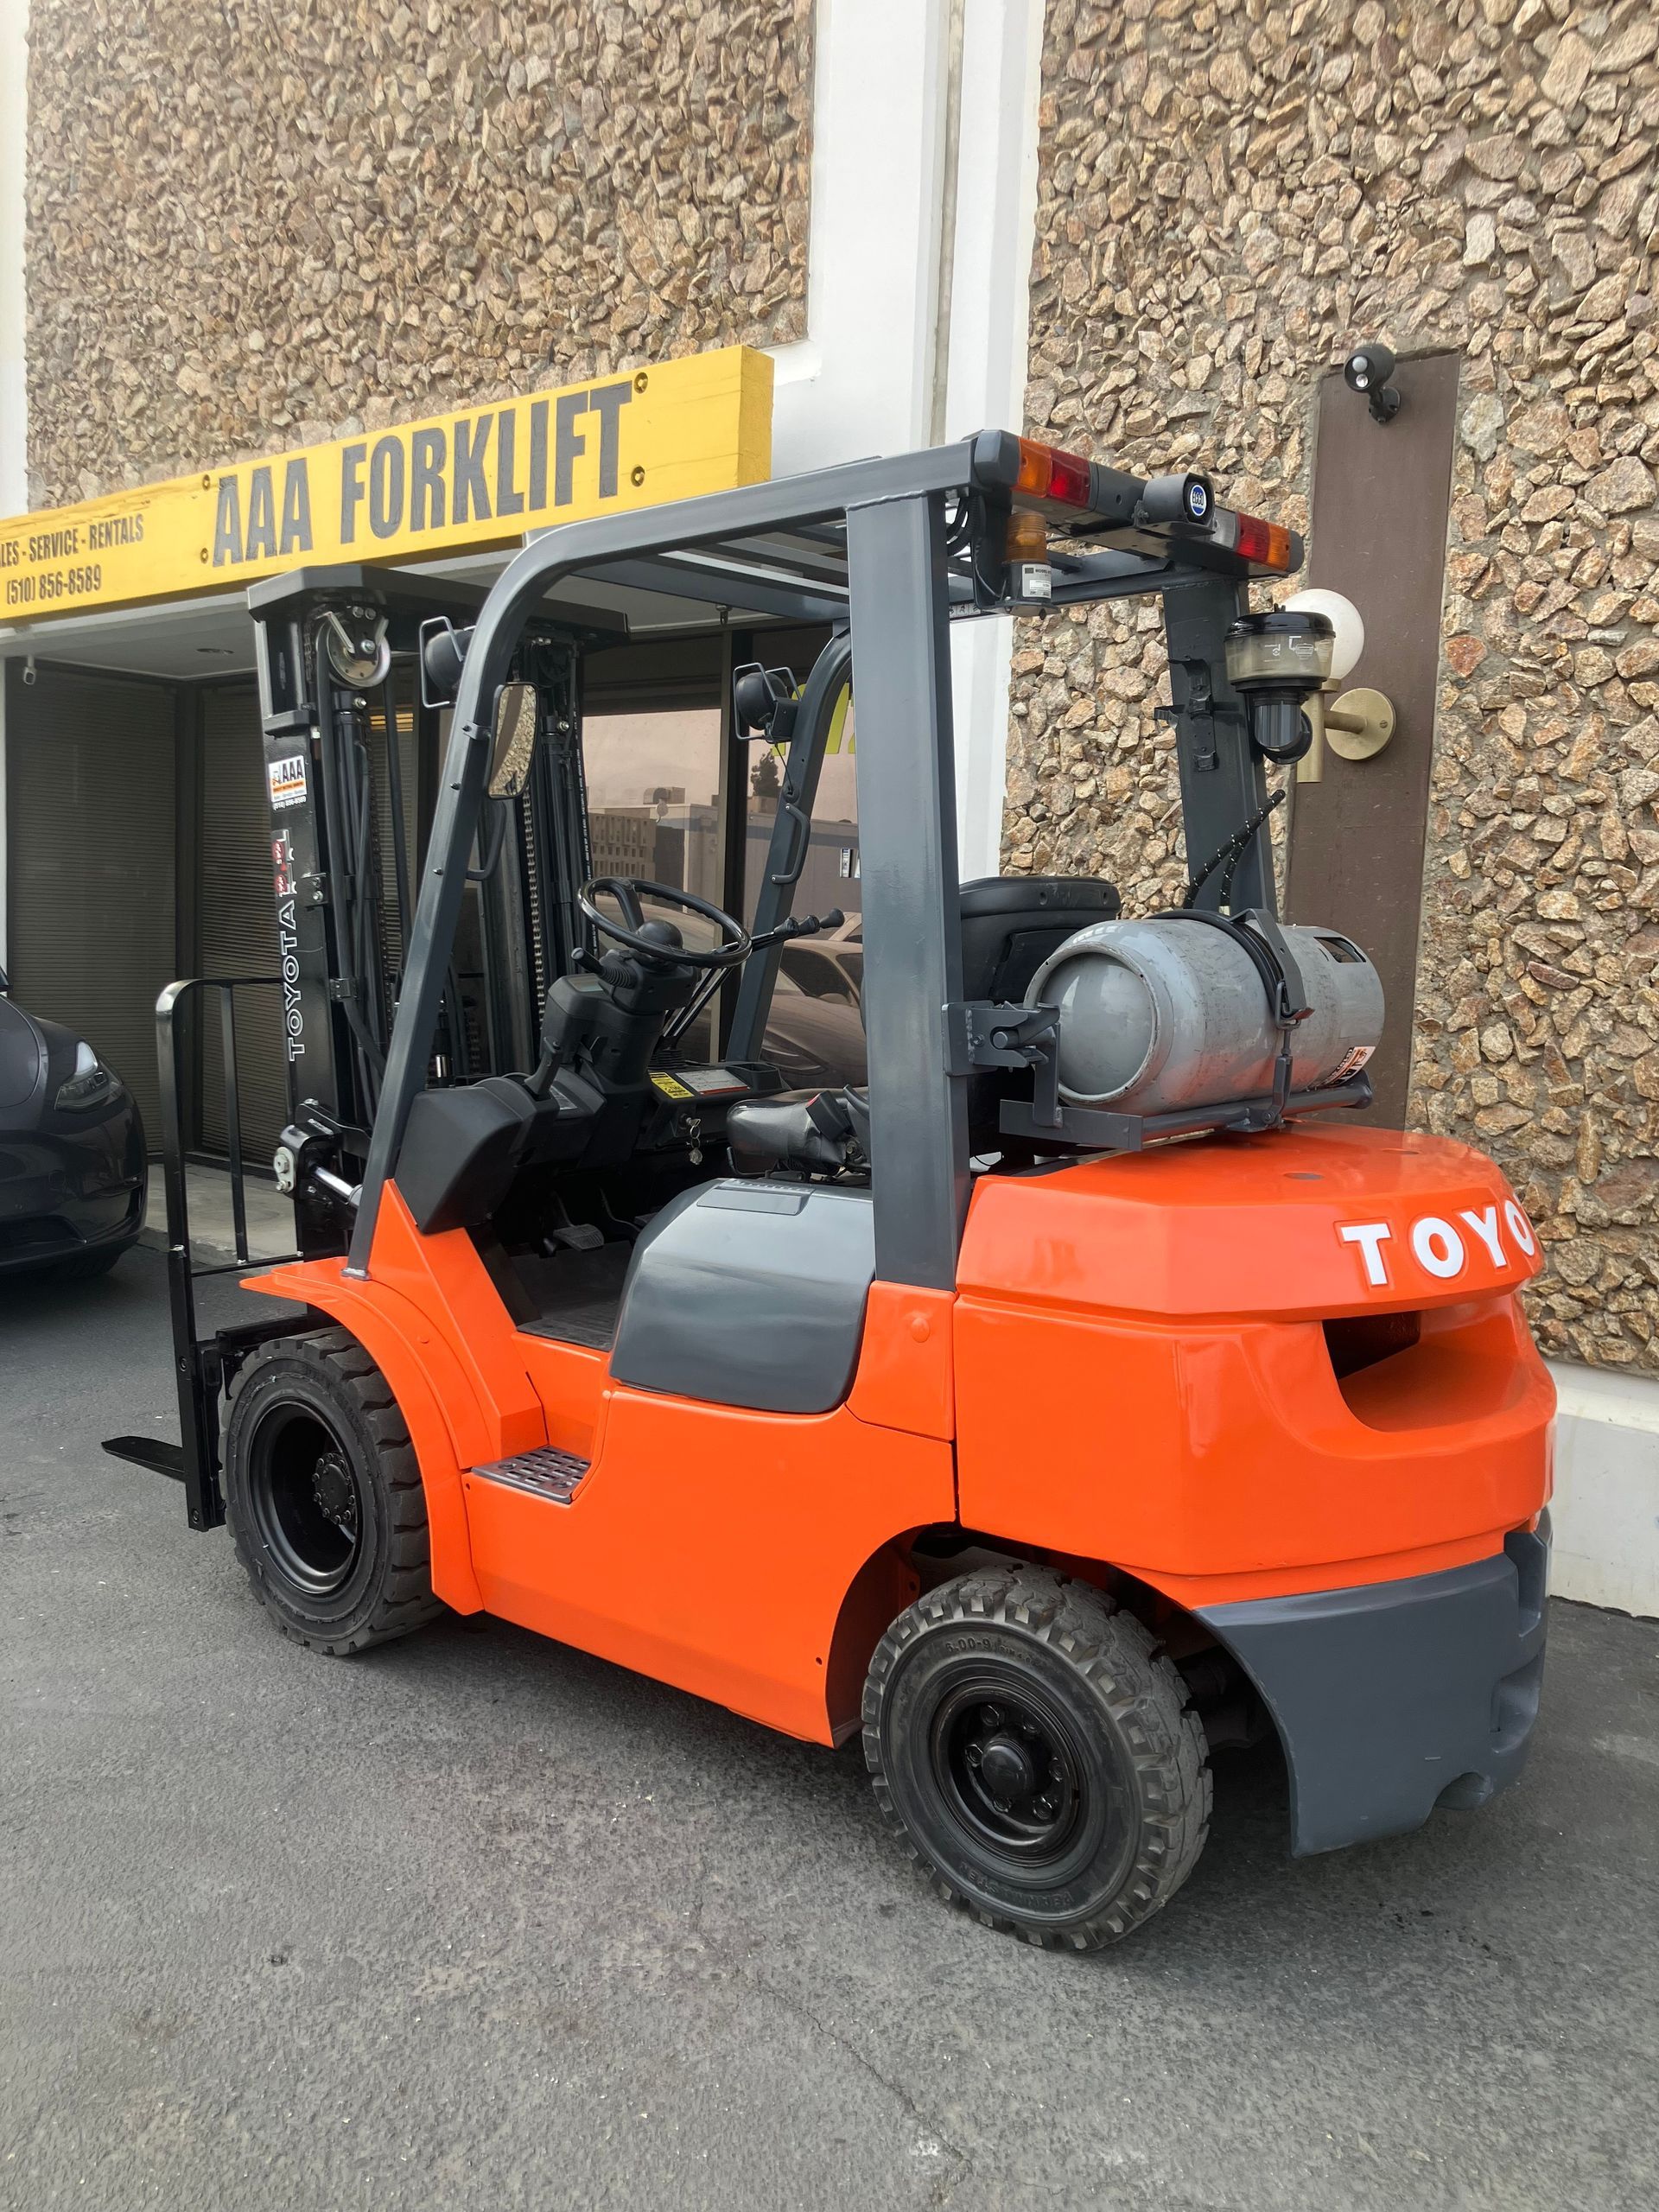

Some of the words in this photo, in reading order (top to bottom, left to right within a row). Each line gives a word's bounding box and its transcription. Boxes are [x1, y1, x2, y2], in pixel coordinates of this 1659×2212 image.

[213, 457, 314, 568] AAA
[340, 380, 632, 544] FORKLIFT
[0, 540, 19, 568] LES
[29, 528, 79, 563] SERVICE
[89, 513, 144, 551] RENTALS
[6, 576, 35, 605] (510)
[39, 563, 102, 601] 856-8589
[282, 760, 304, 783] AAA
[278, 899, 305, 1062] TOYOTA
[1340, 1193, 1535, 1286] TOYO
